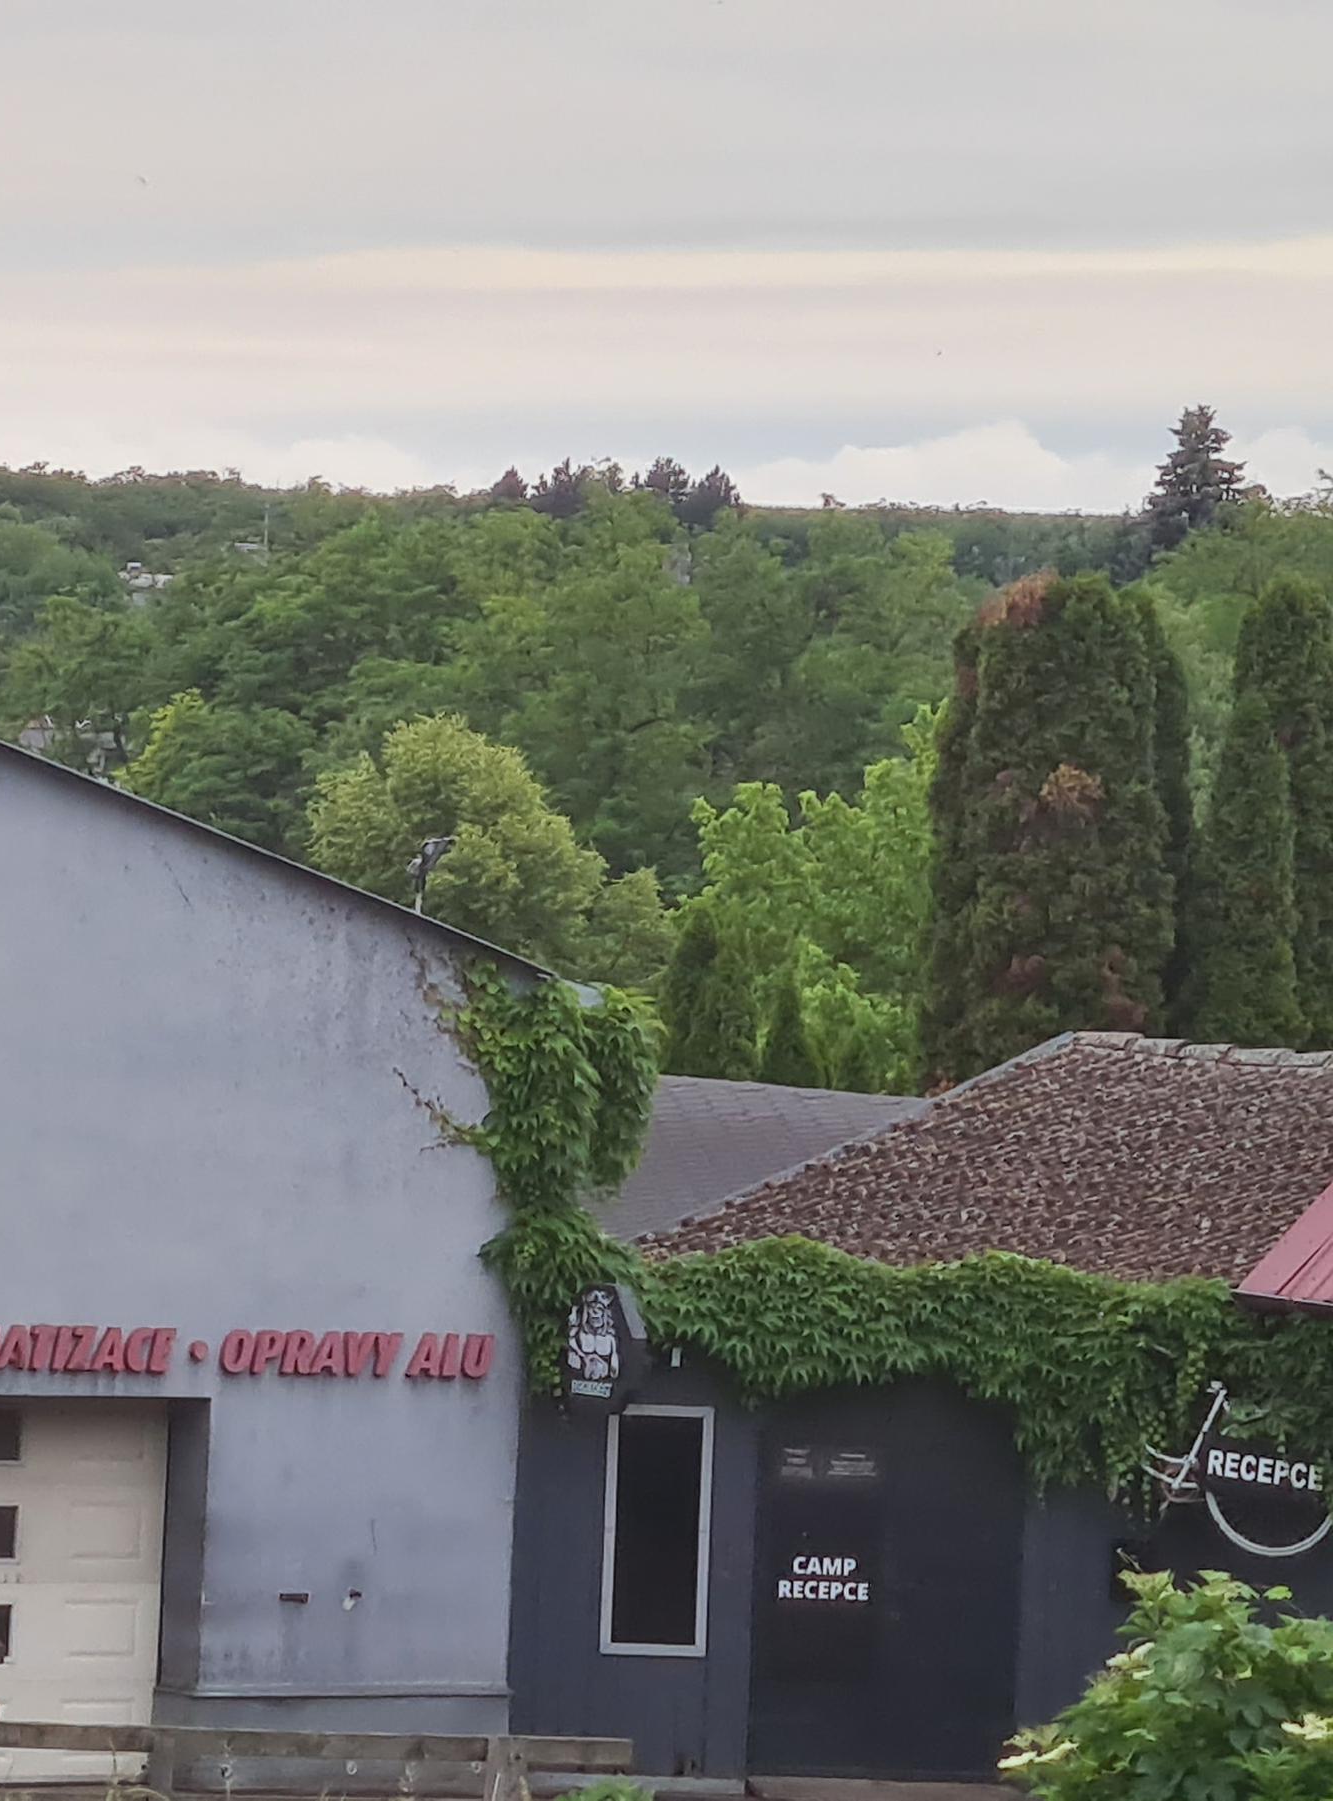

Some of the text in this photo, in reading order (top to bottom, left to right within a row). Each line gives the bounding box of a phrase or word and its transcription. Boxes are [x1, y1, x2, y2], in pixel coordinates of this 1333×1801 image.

[219, 1329, 404, 1377] OPRAVY
[404, 1332, 495, 1379] ALU
[1206, 1449, 1323, 1491] RECEPCE
[792, 1556, 857, 1576] CAMP
[777, 1580, 869, 1601] RECEPCE
